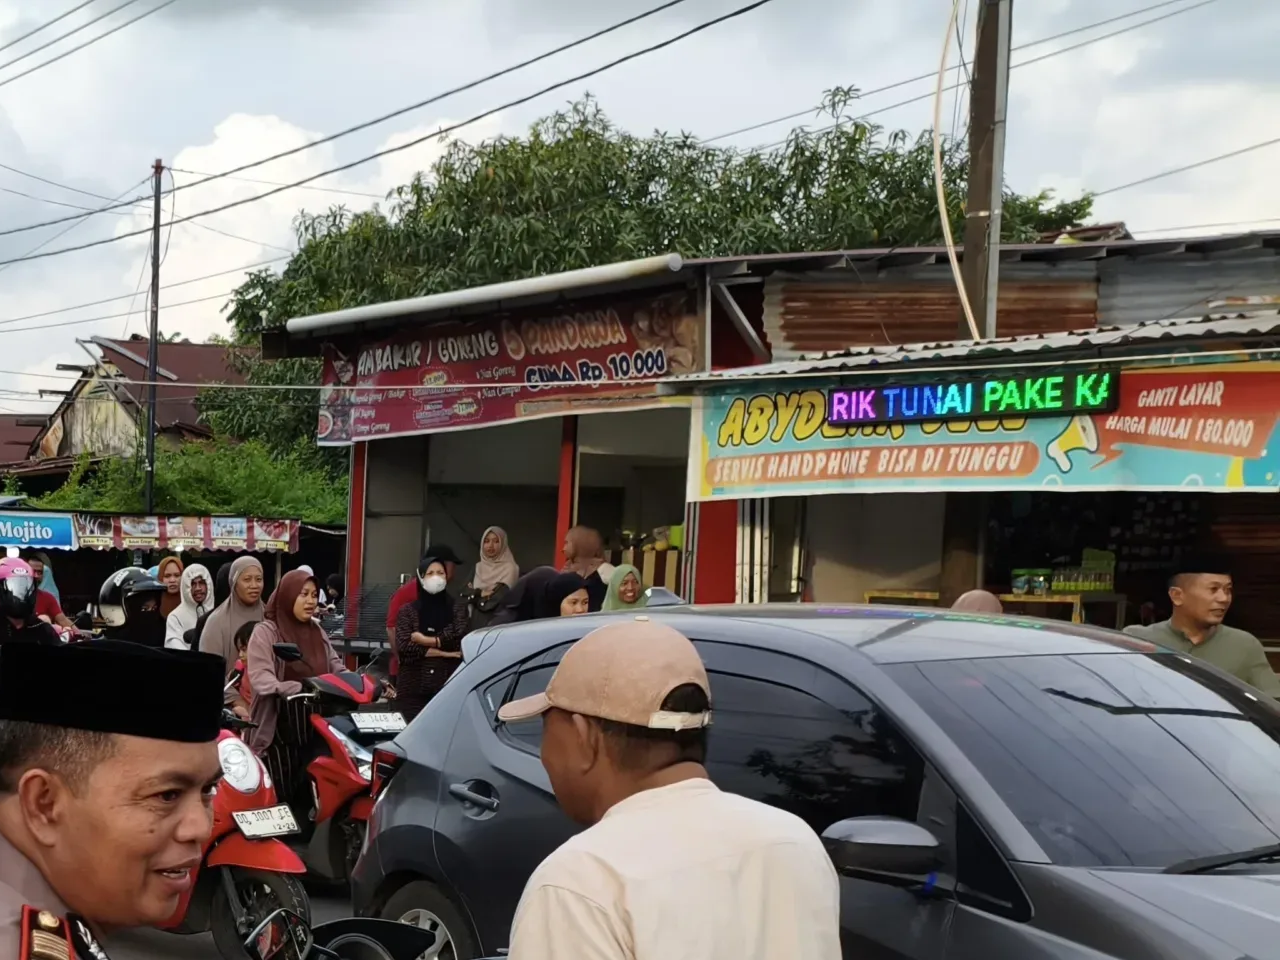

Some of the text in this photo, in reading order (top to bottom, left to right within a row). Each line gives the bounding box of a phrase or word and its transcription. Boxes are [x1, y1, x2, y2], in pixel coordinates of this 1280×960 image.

[437, 329, 499, 363] GORENG
[606, 346, 668, 382] 10.000
[827, 389, 876, 421] RIK
[883, 383, 972, 417] TUNAI
[984, 376, 1064, 412] PAKE
[1137, 380, 1225, 408] GANTI LAYAR
[1105, 415, 1255, 448] HARGA MULAI 180.000
[712, 443, 1025, 484] SERVIS HANDPHONE BISA DI TUNGGU
